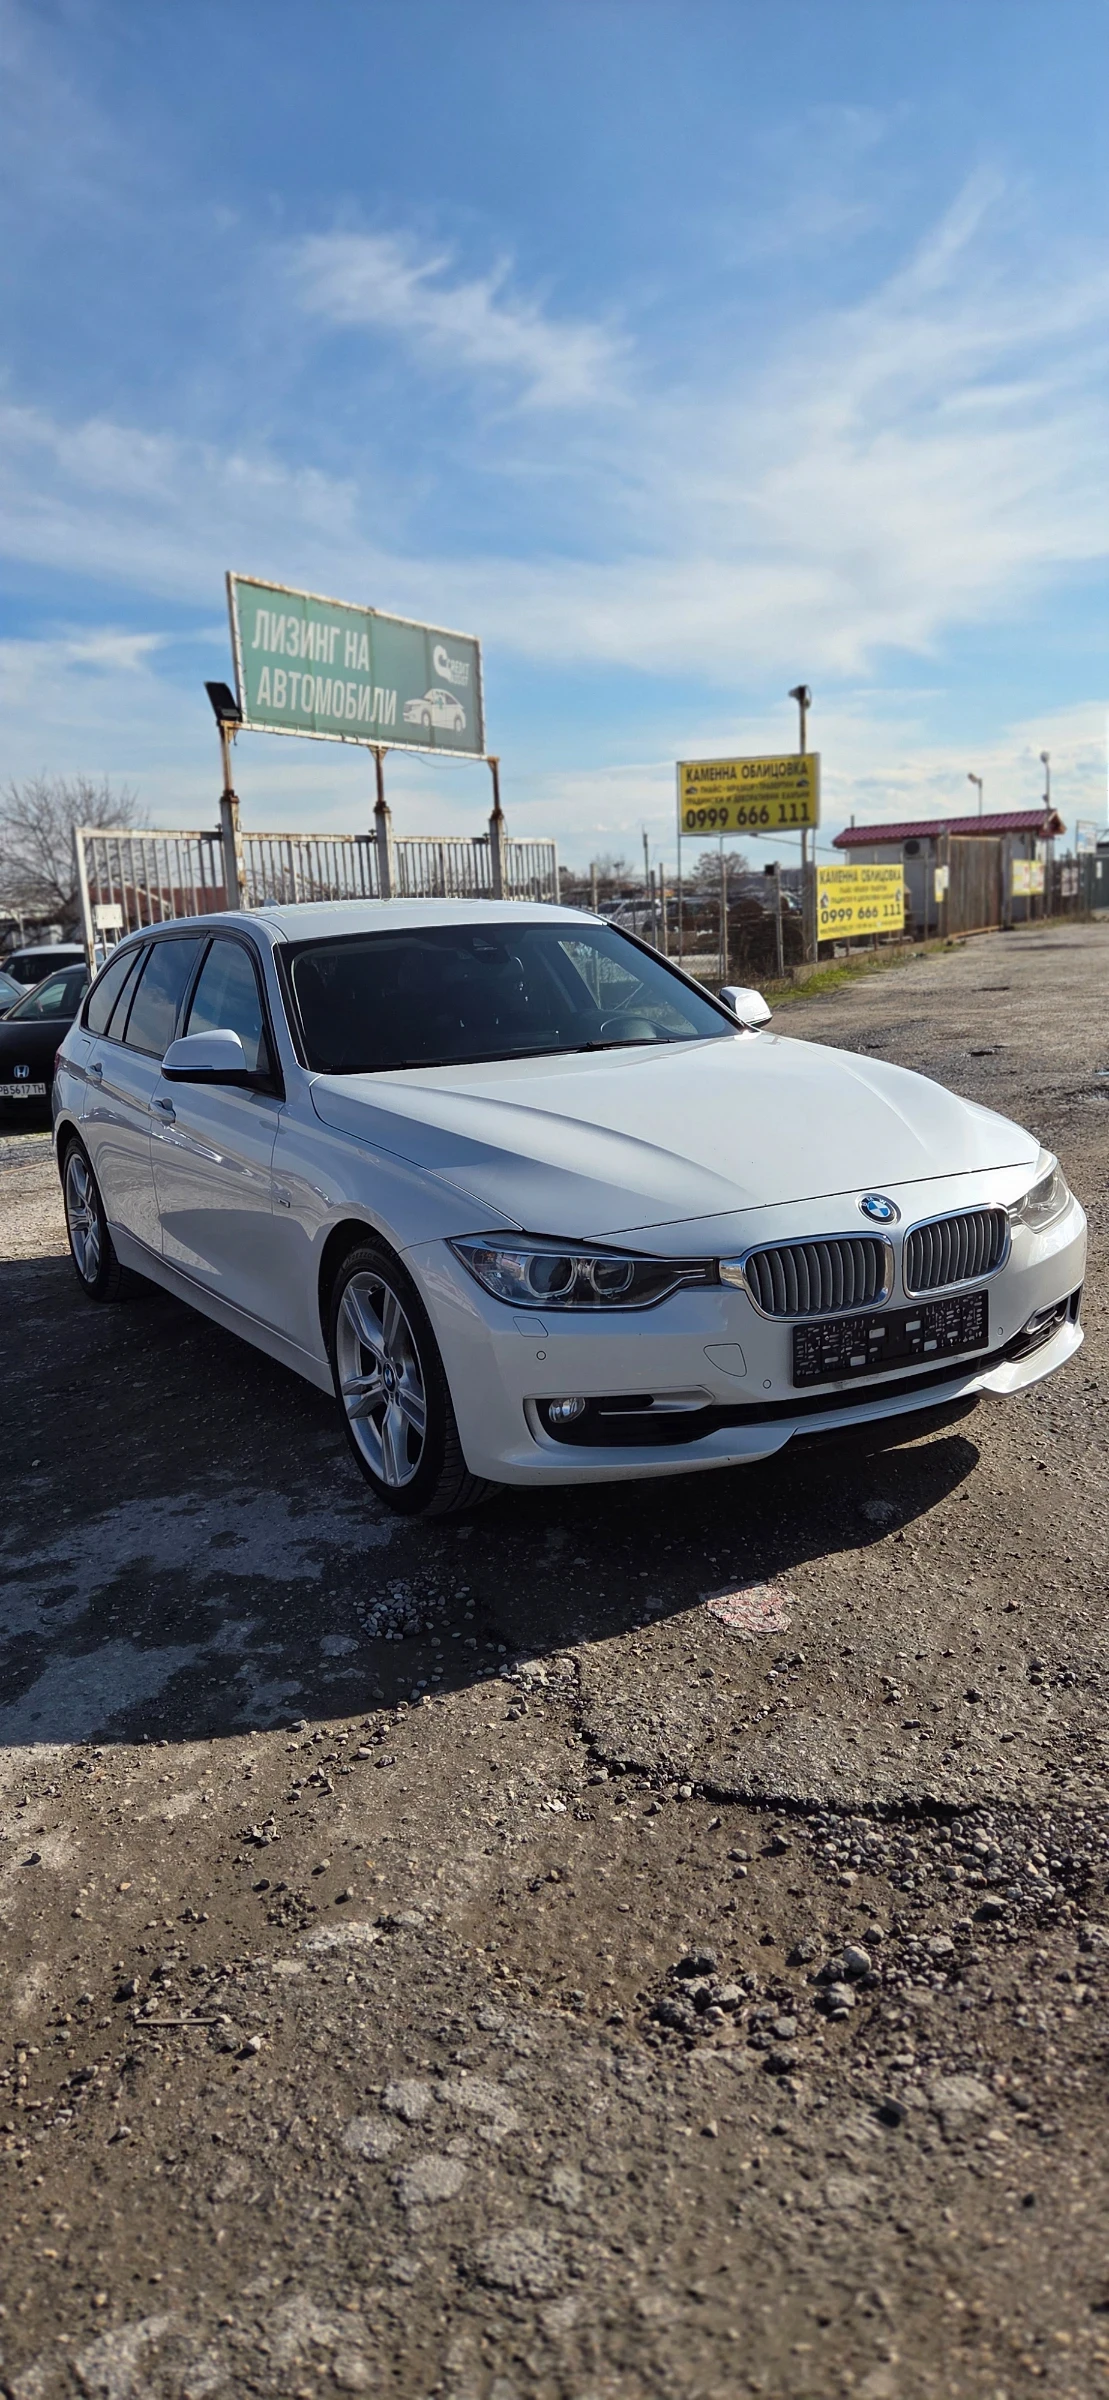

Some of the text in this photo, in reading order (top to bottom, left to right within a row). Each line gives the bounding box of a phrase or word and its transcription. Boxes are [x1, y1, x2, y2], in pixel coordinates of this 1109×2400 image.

[252, 609, 370, 672] ЛИЗИНГ НА
[257, 666, 397, 726] АВТОМОБИЛИ
[686, 761, 808, 783] КАМЕННА ОБЛИЦОВКА
[686, 802, 809, 829] 0999 666 111
[820, 870, 858, 884] КАМЕННА
[821, 903, 901, 924] 0999 666 111
[10, 1084, 31, 1095] 5617
[32, 1084, 44, 1094] TH
